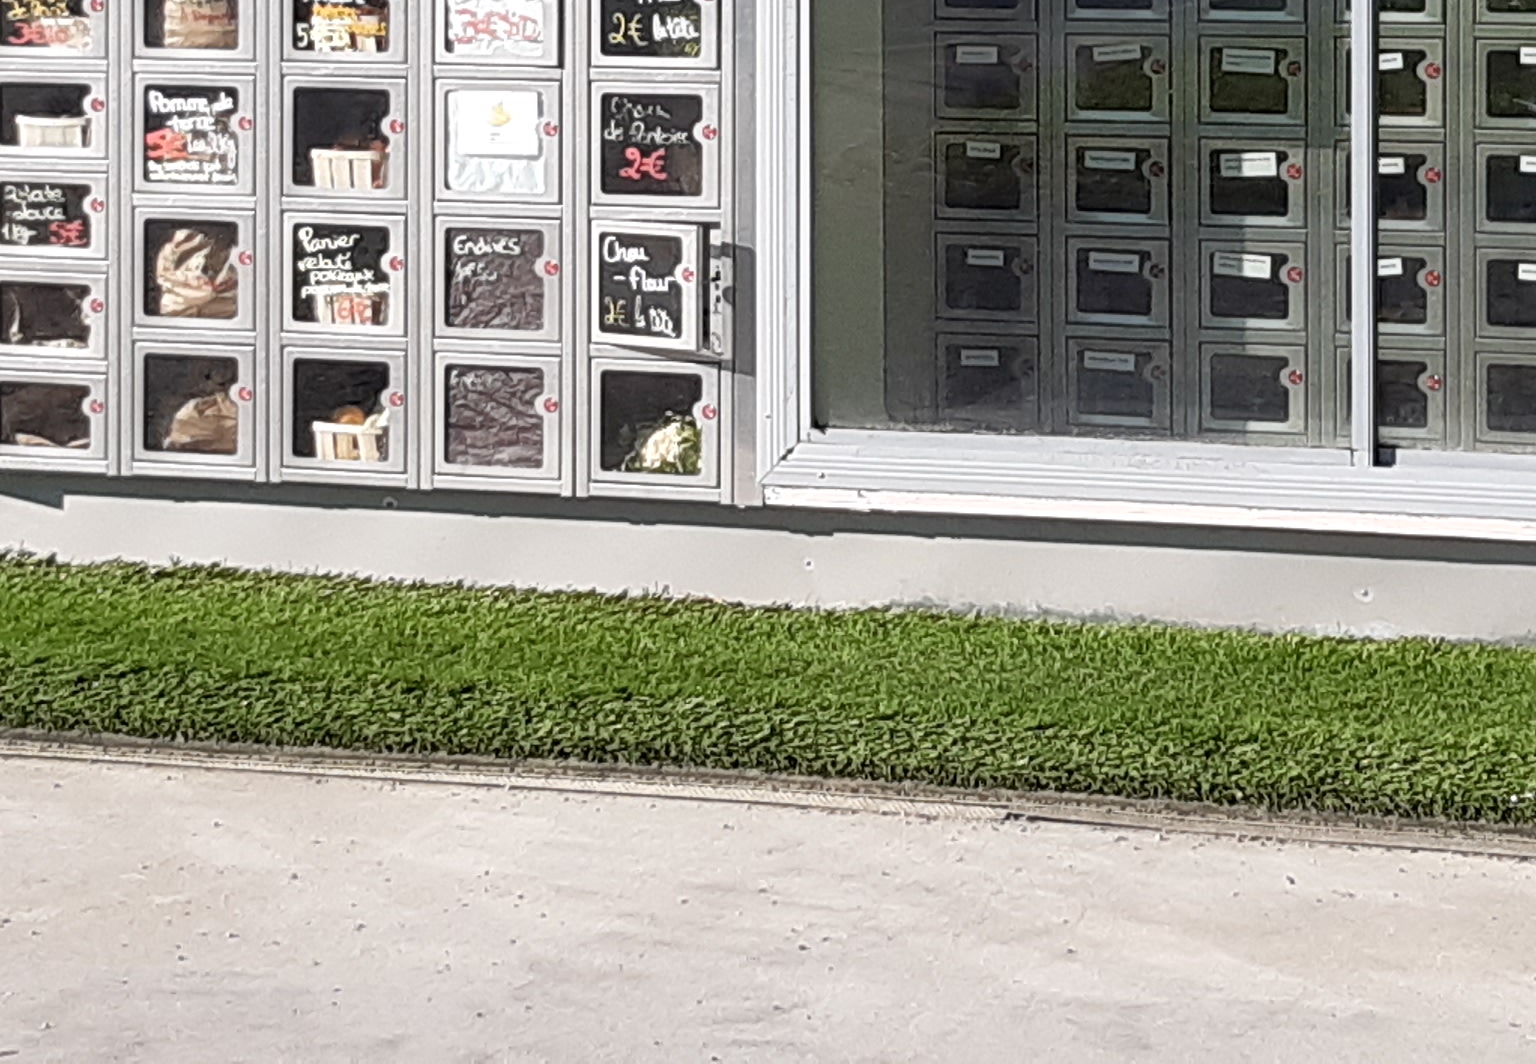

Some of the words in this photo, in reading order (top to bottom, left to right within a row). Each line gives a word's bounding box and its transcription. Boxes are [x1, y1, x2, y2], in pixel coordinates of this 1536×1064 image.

[608, 12, 649, 47] 2€
[619, 146, 668, 180] 2€
[298, 227, 361, 252] Panier
[453, 235, 520, 256] Endives
[604, 236, 649, 263] Chou
